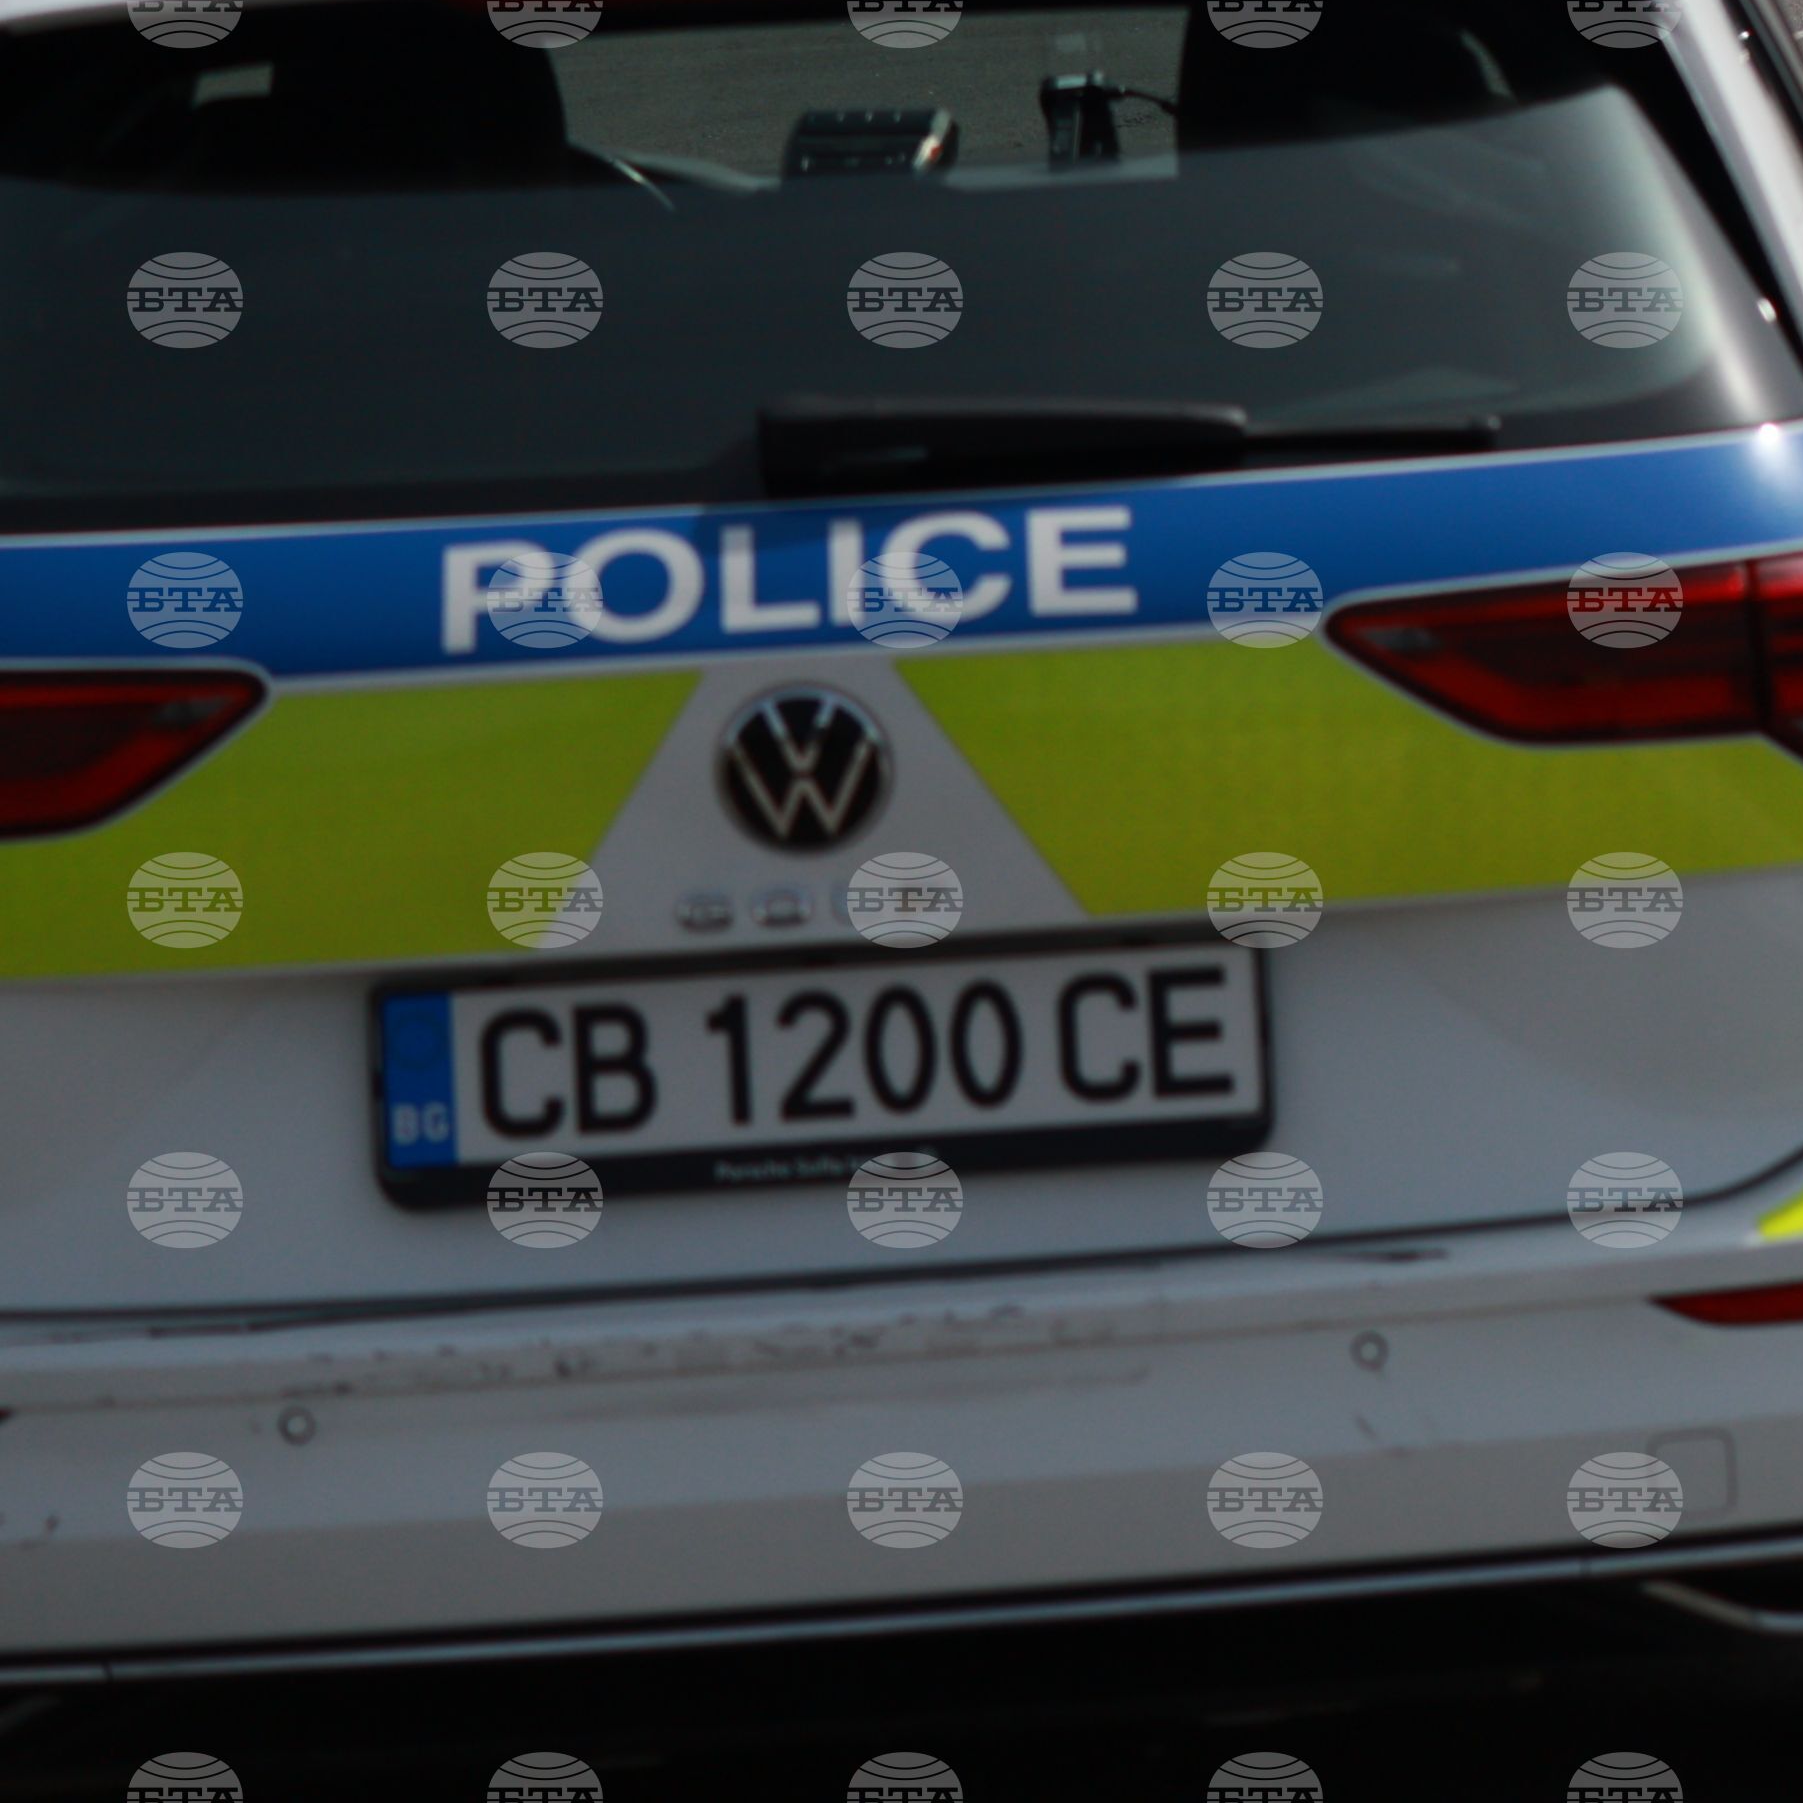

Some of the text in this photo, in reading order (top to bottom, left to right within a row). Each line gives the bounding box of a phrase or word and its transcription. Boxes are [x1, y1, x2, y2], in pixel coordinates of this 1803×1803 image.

[440, 505, 1138, 656] POLICE
[394, 965, 1235, 1145] BG CB 1200 CE
